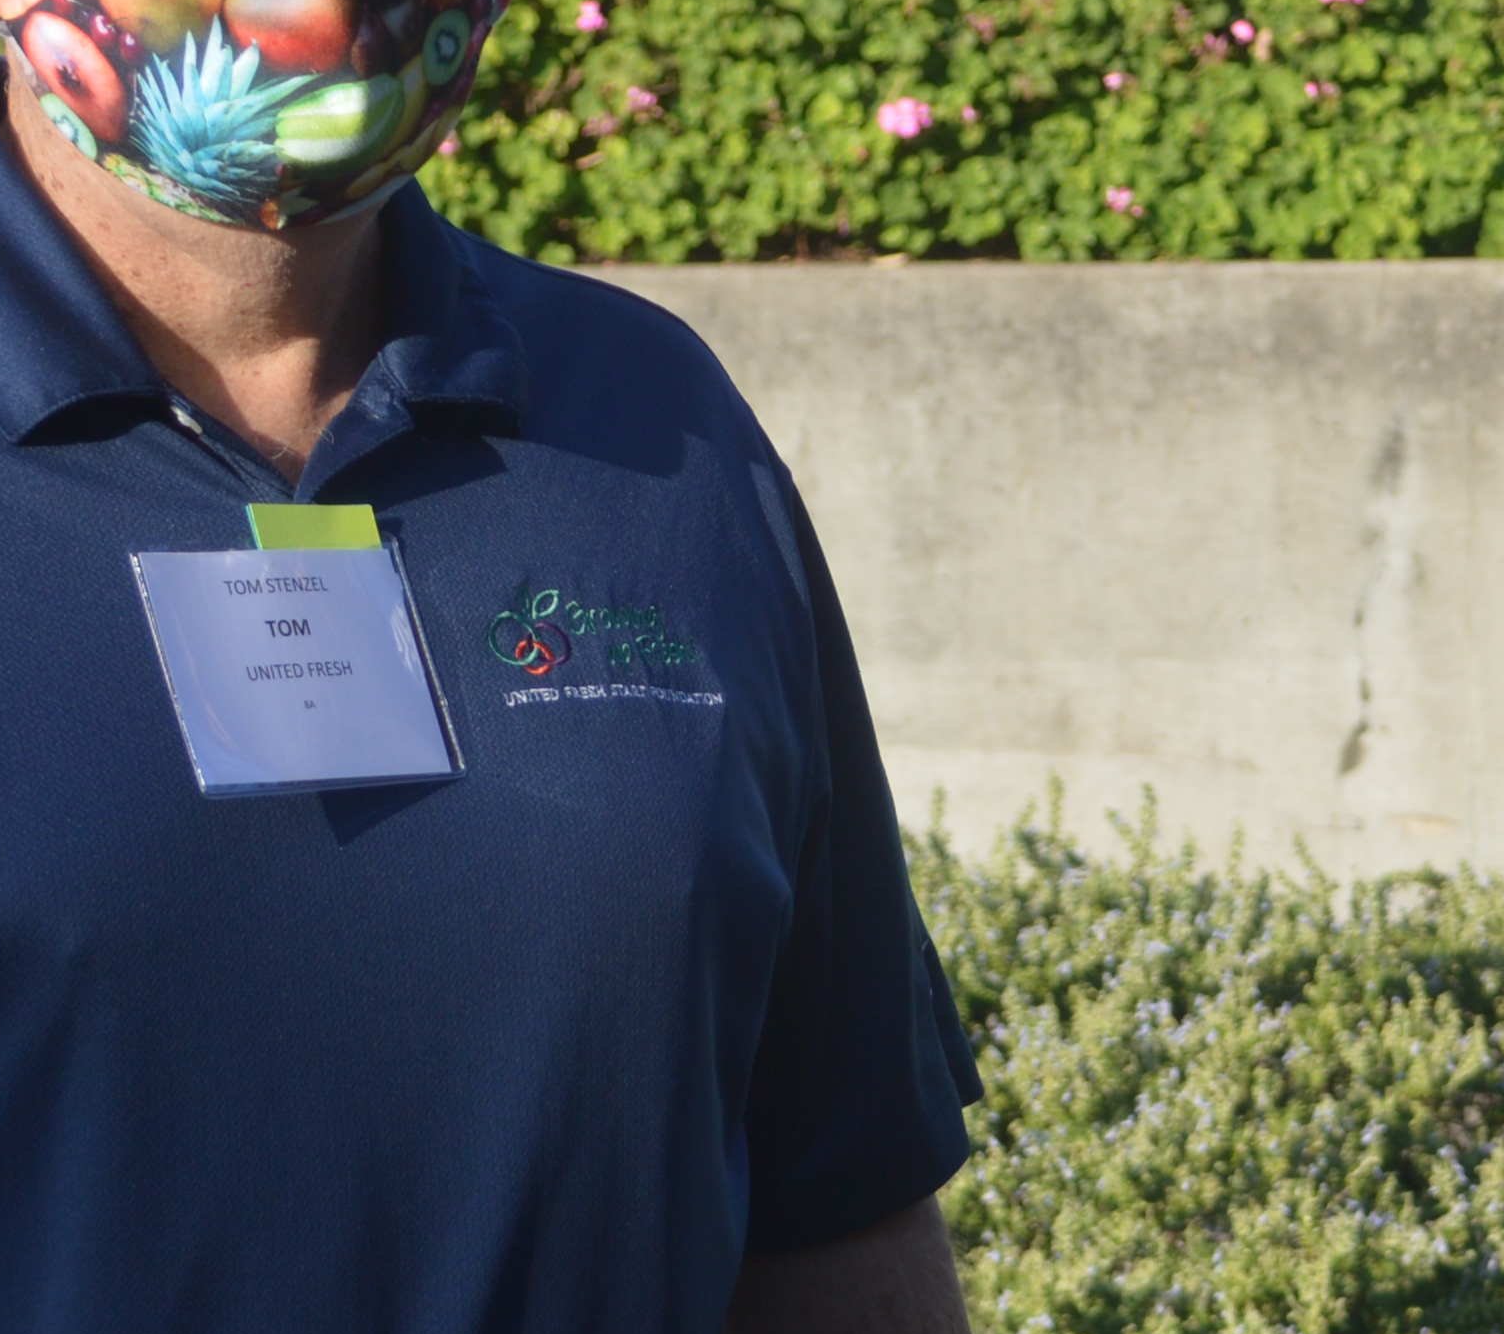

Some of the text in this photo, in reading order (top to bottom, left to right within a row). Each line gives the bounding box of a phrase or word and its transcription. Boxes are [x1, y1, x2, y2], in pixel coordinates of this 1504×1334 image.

[224, 576, 329, 596] TOM STENZEL
[264, 618, 312, 638] TOM
[246, 661, 354, 682] UNITED FRESH
[503, 683, 724, 707] UNITED FRESH START FOUNDATION
